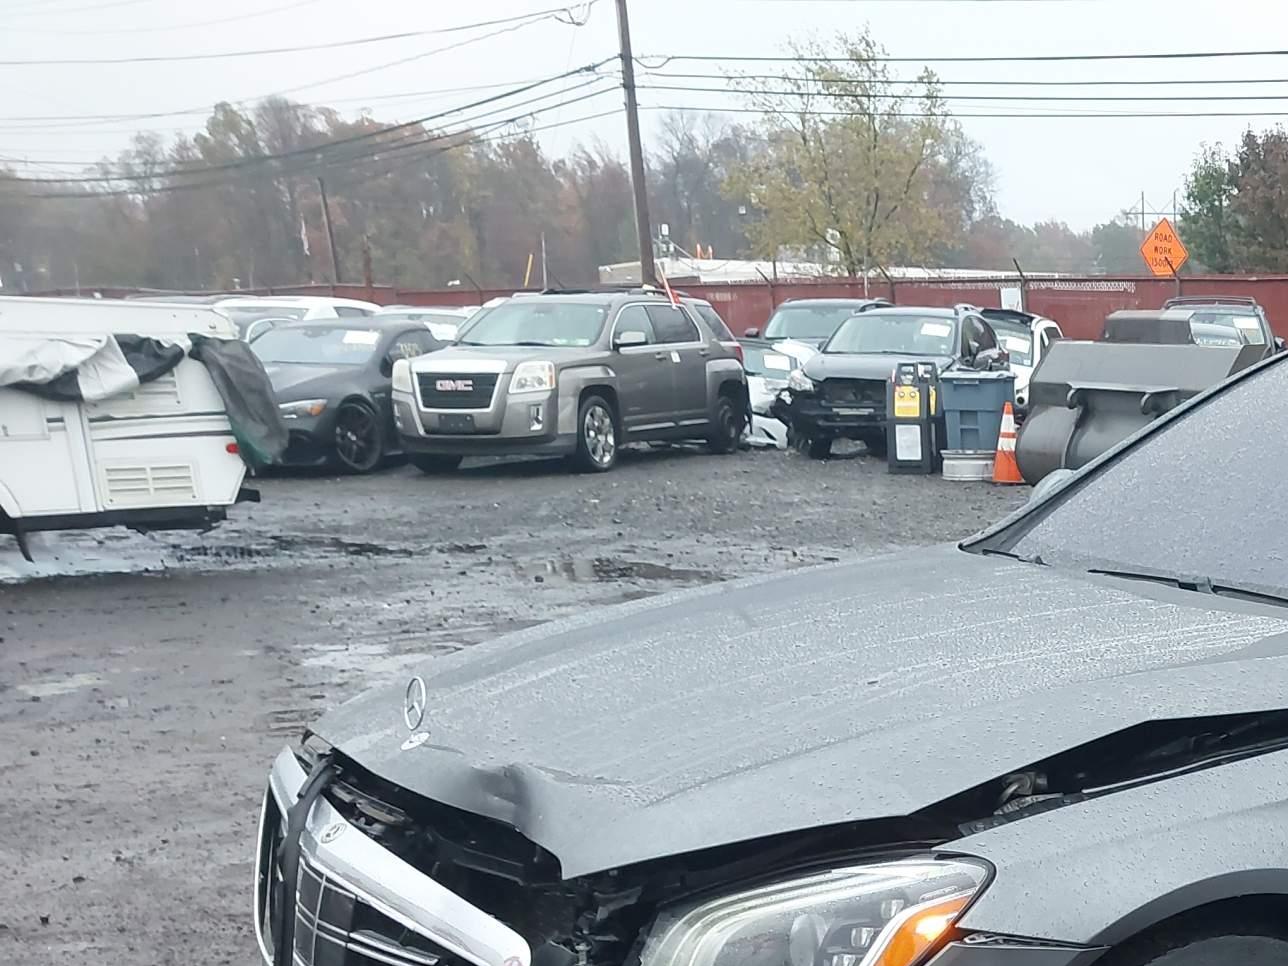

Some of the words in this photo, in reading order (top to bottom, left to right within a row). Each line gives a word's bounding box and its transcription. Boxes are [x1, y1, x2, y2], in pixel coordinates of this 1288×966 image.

[1154, 232, 1173, 243] ROAD
[1154, 245, 1172, 255] WORK
[435, 379, 474, 391] GMC
